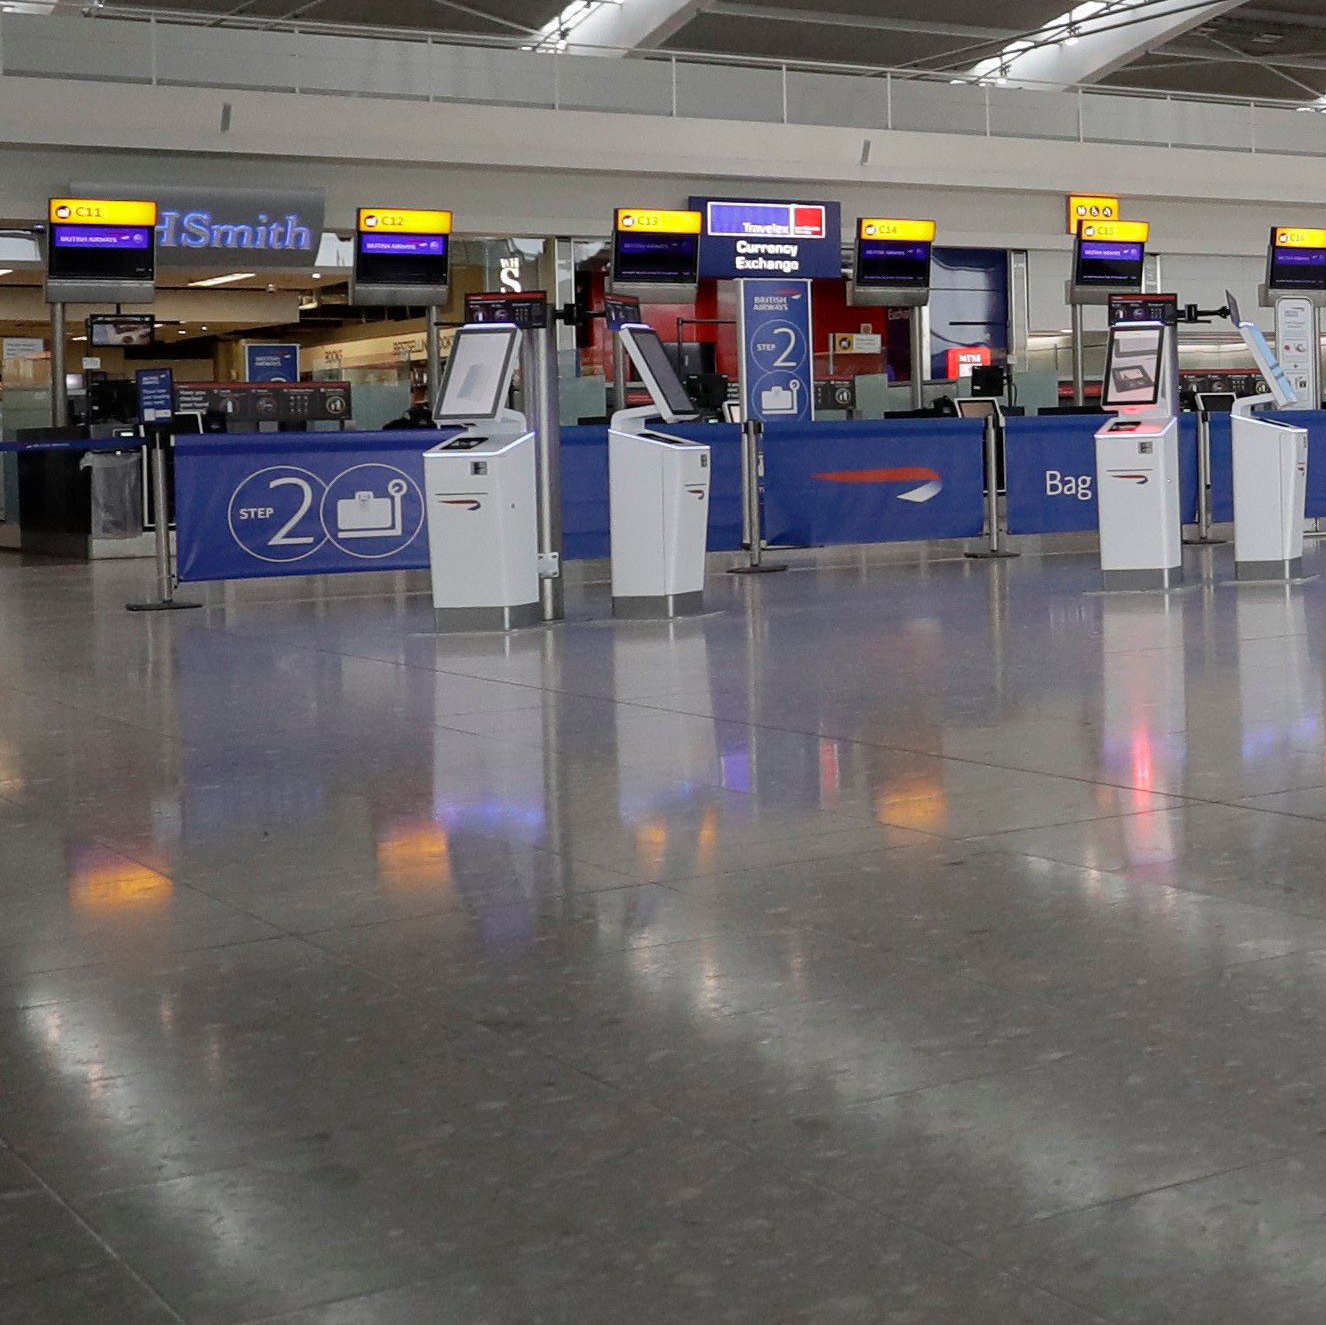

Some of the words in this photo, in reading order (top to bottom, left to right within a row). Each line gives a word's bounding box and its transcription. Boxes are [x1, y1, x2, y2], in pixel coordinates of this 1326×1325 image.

[76, 207, 101, 217] C11
[381, 216, 404, 226] C12
[637, 216, 658, 226] C13
[742, 222, 789, 234] Travelex
[736, 240, 798, 257] Currency
[500, 257, 519, 269] WH
[735, 256, 799, 273] Exchange
[500, 268, 522, 293] S
[756, 343, 776, 351] STEP
[772, 327, 797, 367] 2
[1045, 470, 1092, 500] Bag
[239, 507, 275, 520] STEP
[267, 476, 315, 546] 2
